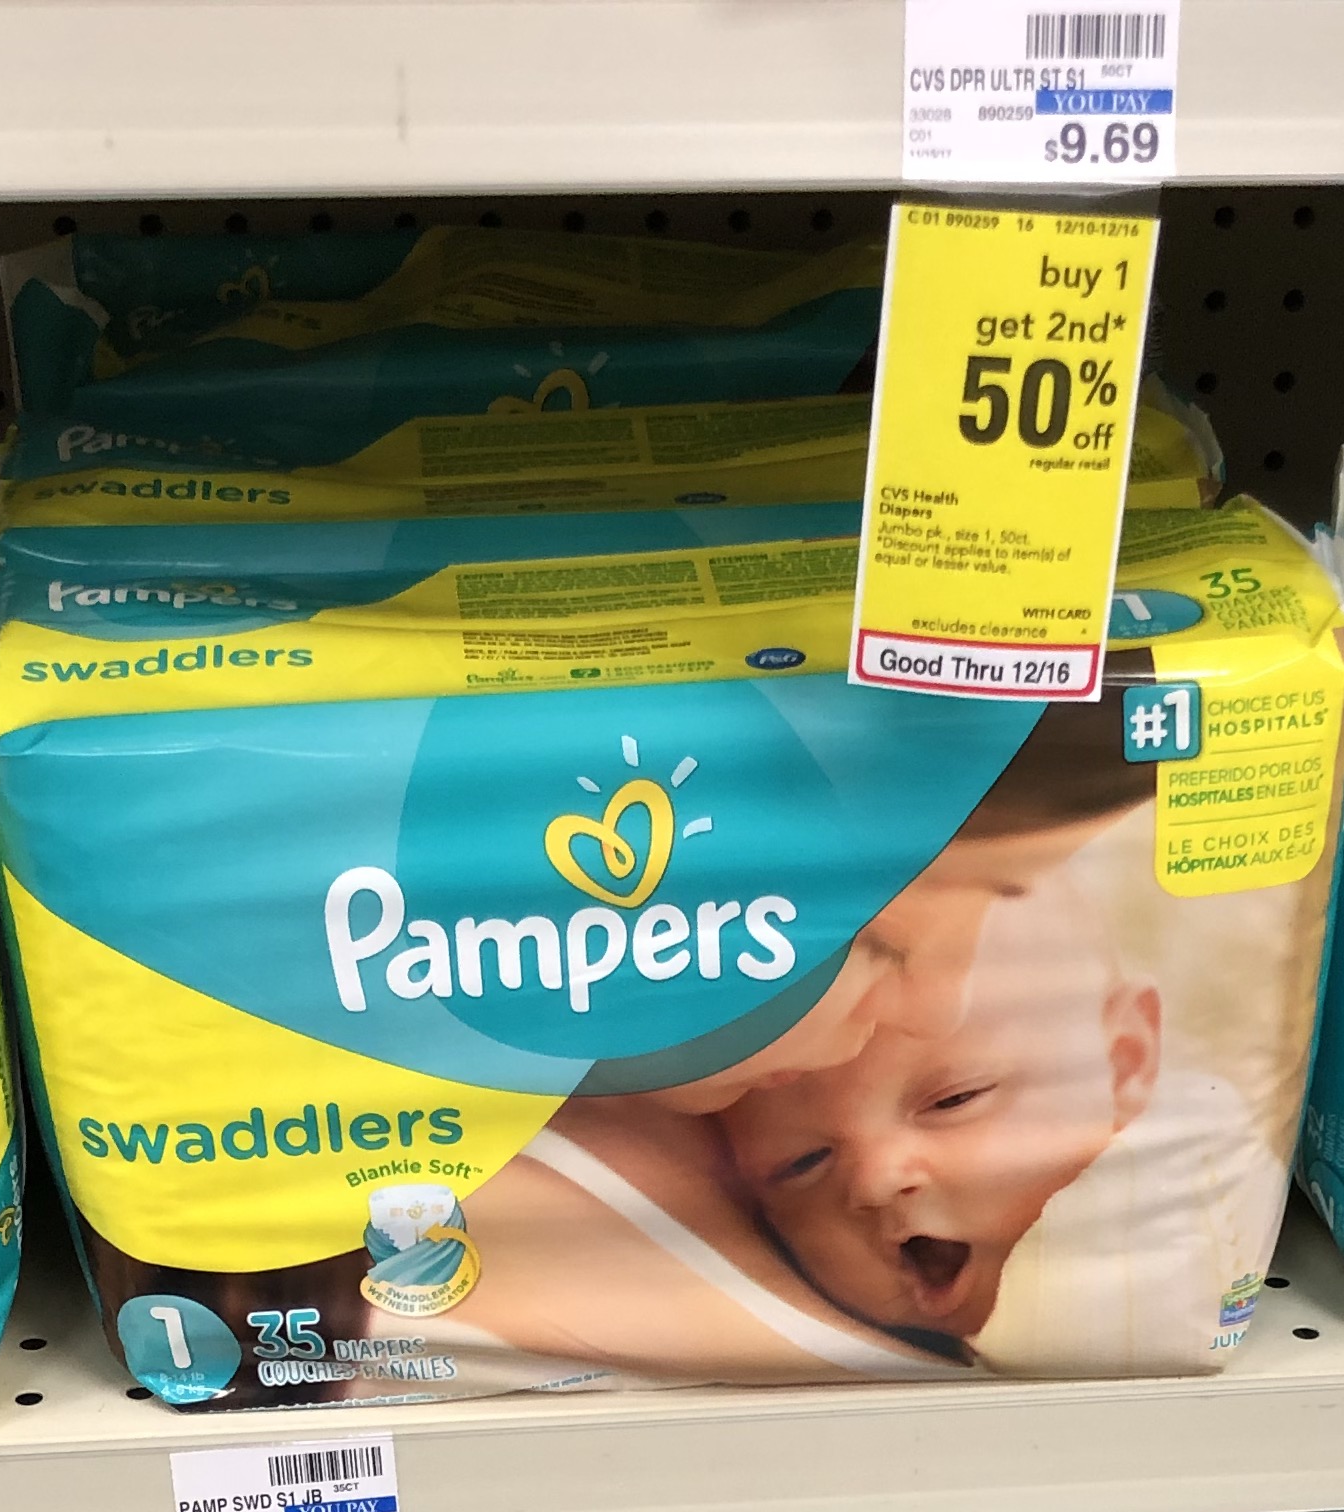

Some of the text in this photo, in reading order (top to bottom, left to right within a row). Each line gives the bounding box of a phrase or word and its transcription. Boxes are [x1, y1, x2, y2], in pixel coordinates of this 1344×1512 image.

[910, 69, 1085, 92] CVS DPR ULTR ST S1
[1055, 94, 1151, 112] YOU PAY
[1045, 122, 1159, 164] $9.69
[1040, 255, 1128, 297] buy 1
[976, 314, 1034, 346] get
[959, 356, 1117, 449] 50%
[1073, 423, 1114, 450] off
[1030, 457, 1110, 471] regular retail
[880, 502, 932, 519] Diapers
[881, 487, 959, 506] CVS Health
[912, 617, 1047, 639] excludes clearance
[1023, 607, 1091, 620] WITH CARD
[21, 643, 315, 683] swaddlers
[880, 649, 1070, 684] Good Thru 12/16
[1208, 690, 1325, 716] CHOICE OF US
[1130, 689, 1190, 750] #1
[324, 866, 797, 1013] Pampers
[80, 1101, 465, 1165] swaddlers
[344, 1157, 422, 1190] Blankie
[150, 1307, 192, 1369] 1
[246, 1308, 425, 1362] 35 DIAPERS
[232, 1495, 273, 1511] SWD
[277, 1491, 295, 1507] S1
[301, 1489, 323, 1505] JB
